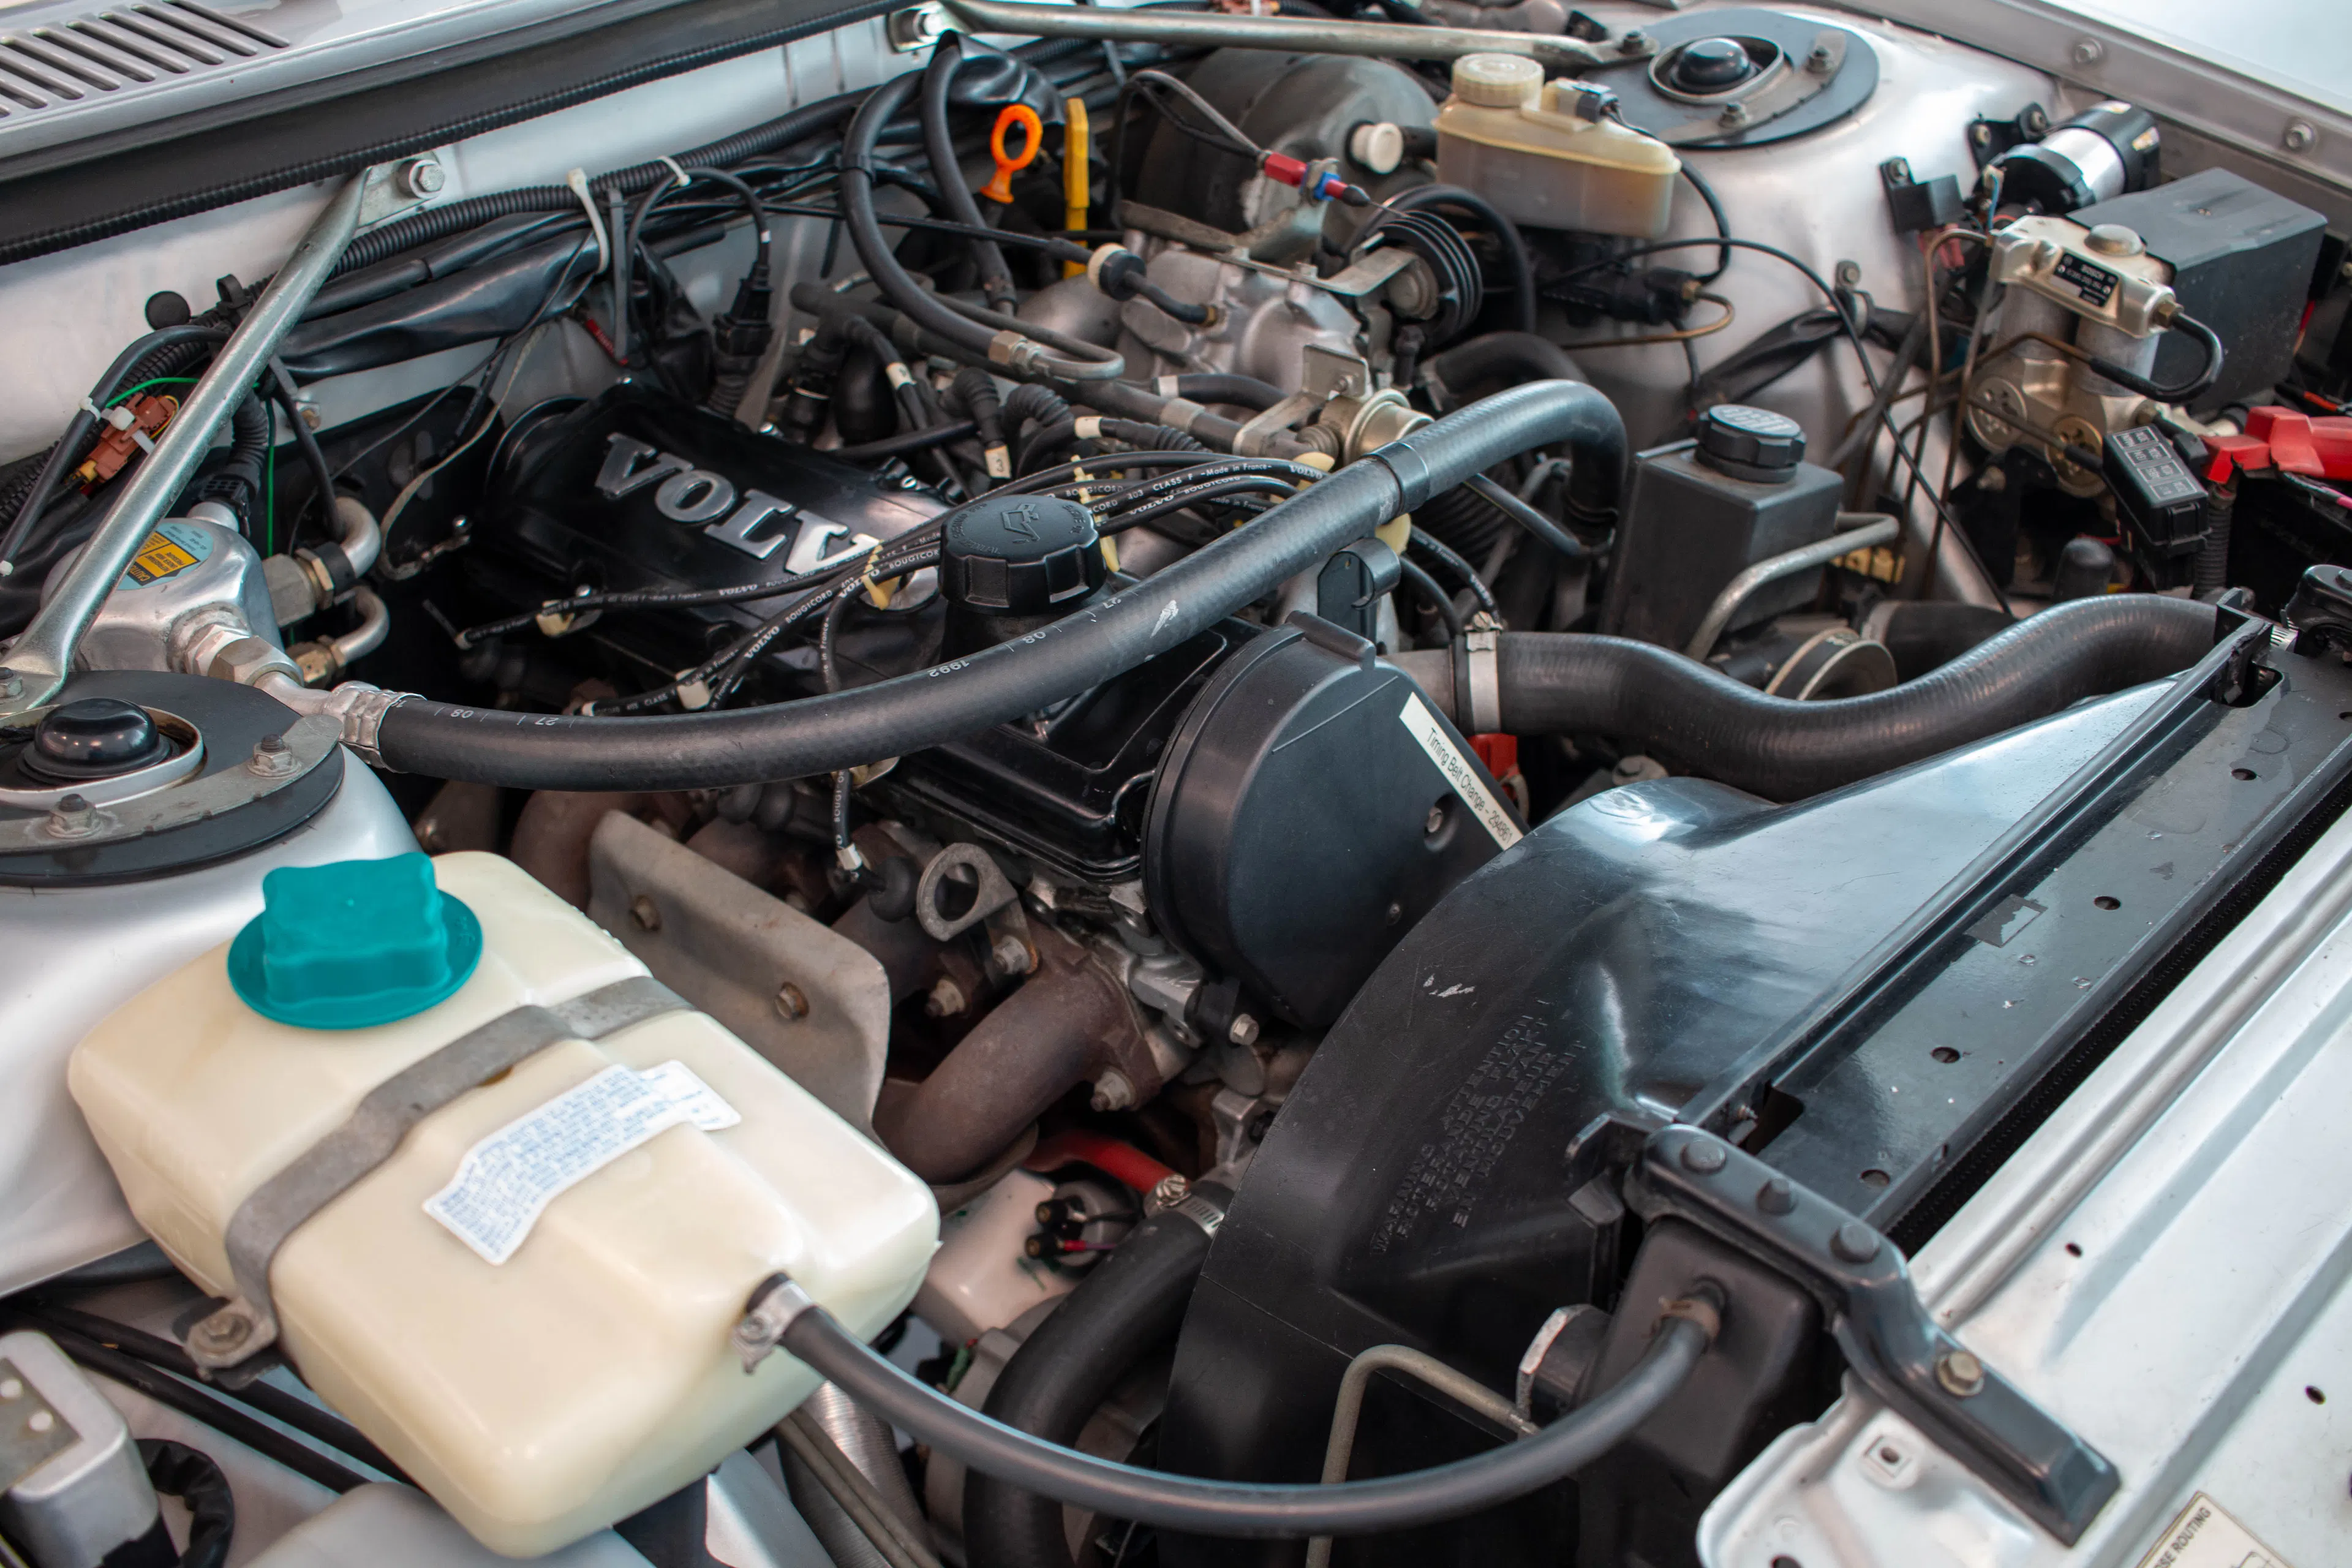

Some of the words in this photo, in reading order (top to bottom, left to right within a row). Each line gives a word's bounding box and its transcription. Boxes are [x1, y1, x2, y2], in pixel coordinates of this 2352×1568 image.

[1288, 464, 1323, 480] VOLVO
[1066, 485, 1123, 497] BOGICORD
[1153, 477, 1183, 491] CLASS
[1129, 494, 1175, 515] VOLVO
[889, 548, 940, 570] BOUGICOR
[129, 565, 151, 581] CAUTIO
[718, 584, 758, 596] VOLVO
[839, 568, 880, 598] VOLO
[785, 589, 833, 624] BOUGICORD
[1102, 597, 1122, 609] 27
[744, 625, 780, 659] VOLVO
[1022, 631, 1047, 644] 08
[929, 660, 970, 677] 1992
[644, 694, 668, 706] CLASS
[450, 708, 475, 719] 08
[534, 717, 560, 726] 27
[1427, 727, 1450, 767] Timing
[1447, 756, 1464, 783] Belt
[1461, 774, 1485, 812] Change
[1440, 1014, 1534, 1131] ATTENTION
[1425, 1095, 1503, 1213] ROTATING
[1505, 1041, 1548, 1082] FAN
[1452, 1191, 1478, 1229] EN
[2153, 1550, 2177, 1568] SE
[2170, 1506, 2211, 1554] ROUTING
